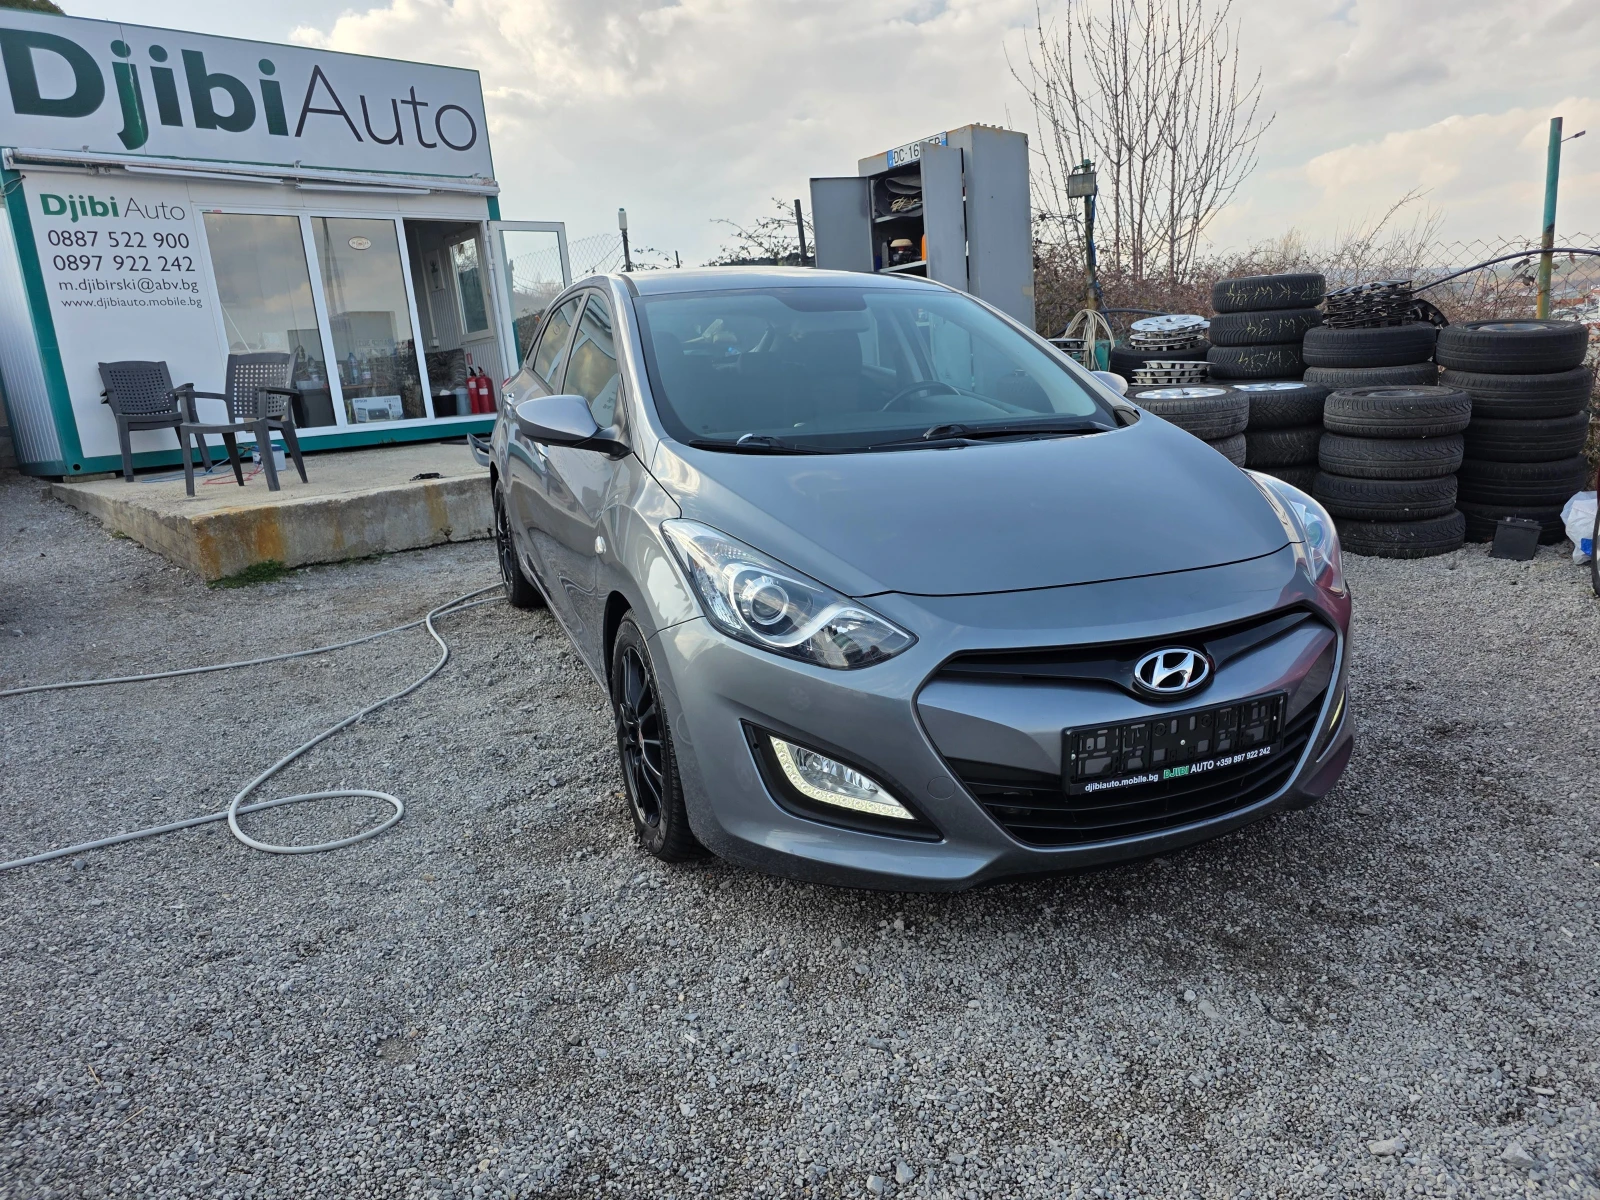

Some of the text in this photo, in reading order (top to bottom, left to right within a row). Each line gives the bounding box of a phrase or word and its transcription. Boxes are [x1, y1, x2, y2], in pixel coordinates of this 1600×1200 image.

[39, 193, 185, 223] Djibi Auto
[47, 229, 190, 249] 0887 522 900
[53, 254, 196, 272] 0897 922 242
[58, 277, 199, 294] m.djibirski@abv.bg
[61, 296, 203, 310] www.djibiauto.mobile.bg
[1085, 746, 1271, 792] djibiauto.mobile.bg DJIBI AUTO +359 897 922 242
